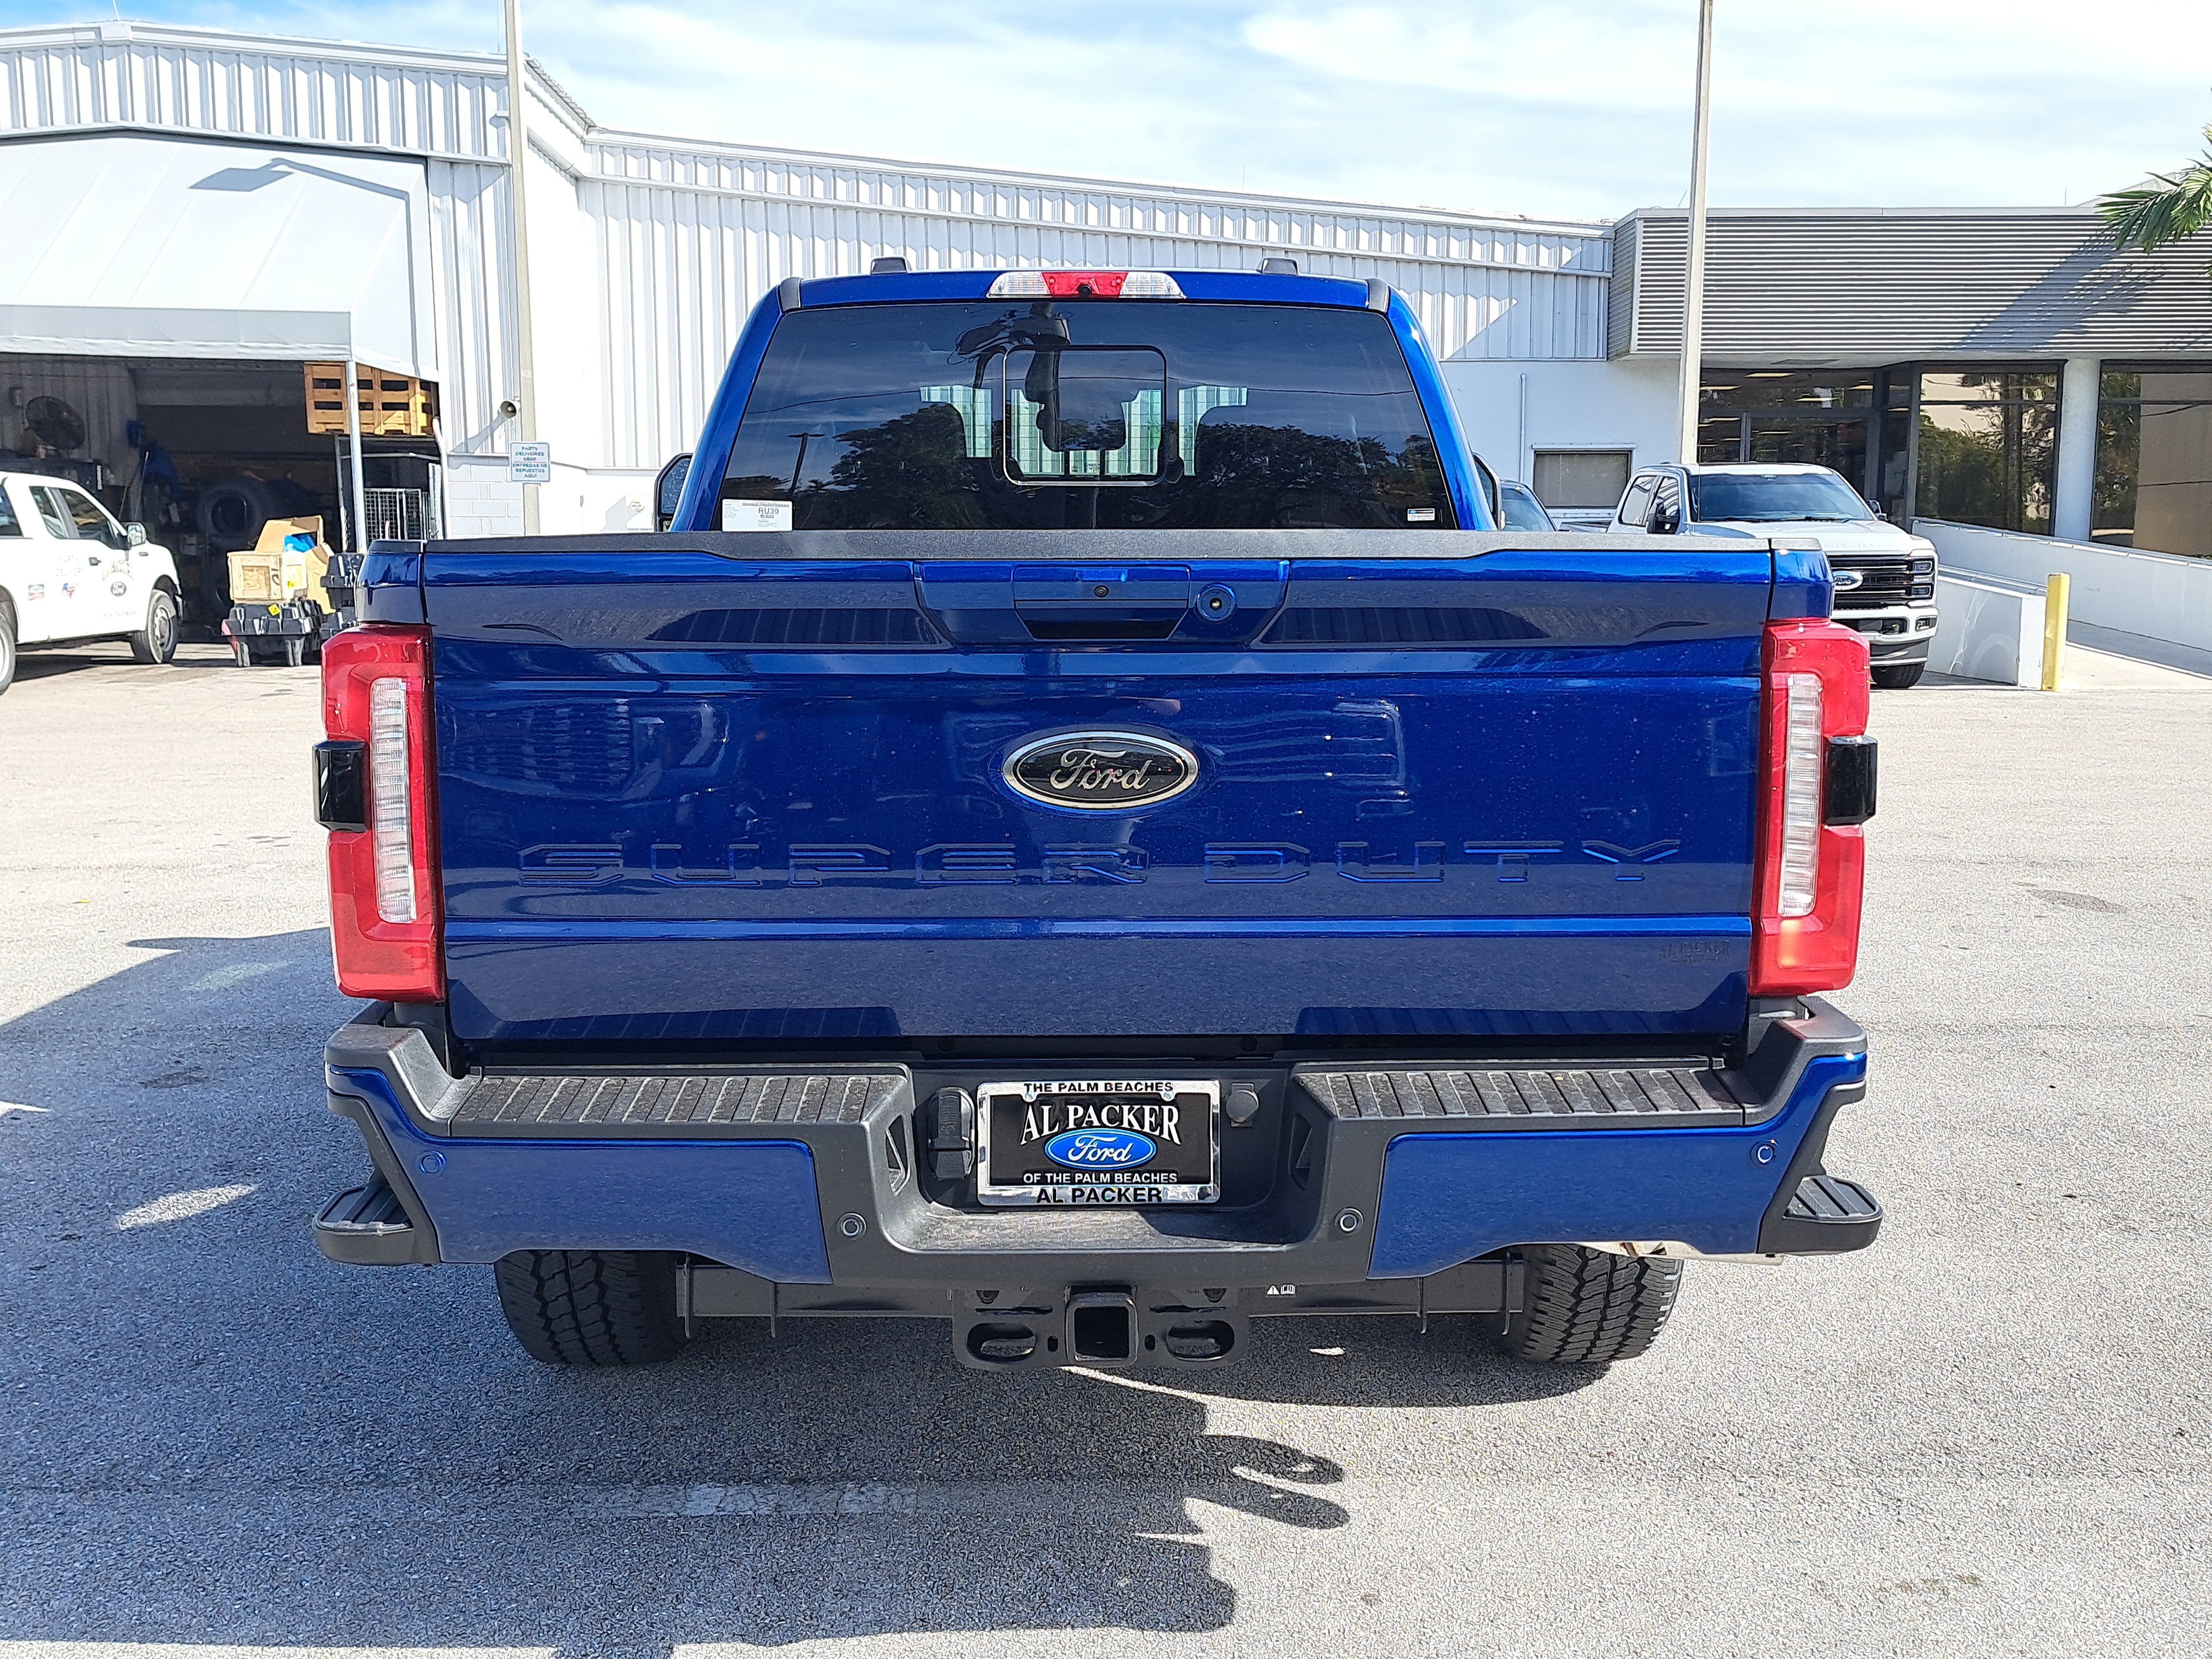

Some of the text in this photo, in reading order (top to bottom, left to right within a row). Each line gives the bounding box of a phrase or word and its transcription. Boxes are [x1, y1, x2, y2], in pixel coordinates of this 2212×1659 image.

[1051, 748, 1154, 790] Ford
[517, 839, 1681, 887] SUPER DUTY
[1024, 1082, 1173, 1093] THE PALM BEACHES
[1020, 1104, 1182, 1146] AL PACKER
[1068, 1135, 1134, 1161] Ford
[1023, 1173, 1177, 1183] OF THE PALM BEACHES
[1036, 1187, 1162, 1203] AL PACKER
